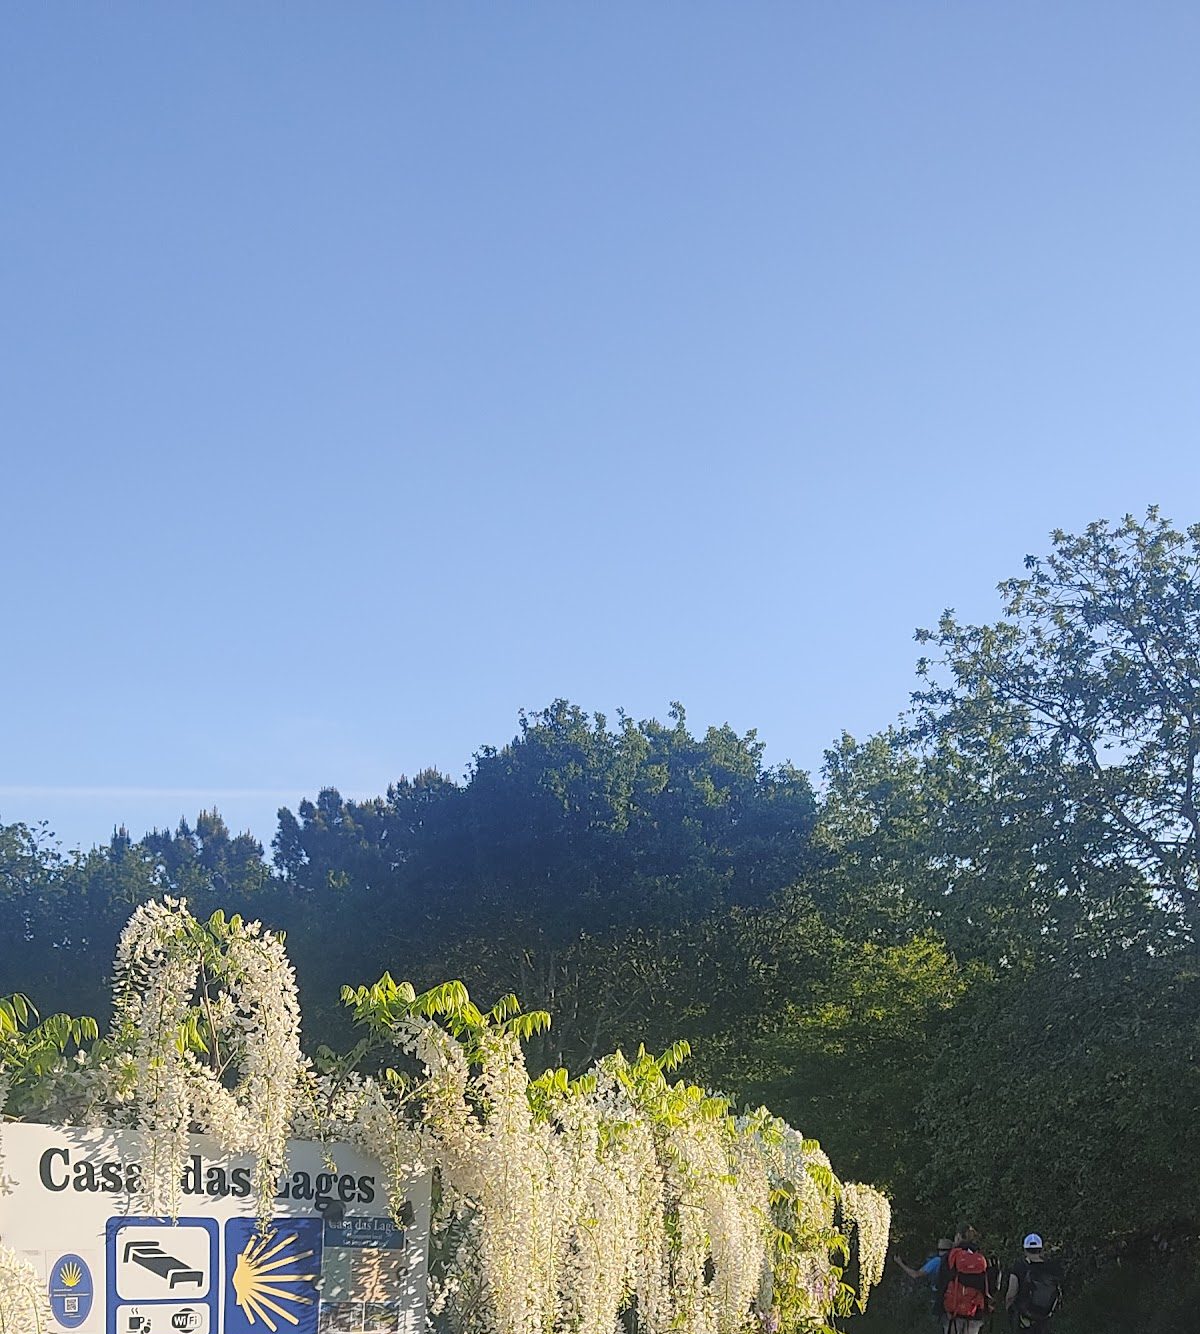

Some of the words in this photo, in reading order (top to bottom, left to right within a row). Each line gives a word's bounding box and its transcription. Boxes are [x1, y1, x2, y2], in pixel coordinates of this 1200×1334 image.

[39, 1147, 146, 1194] Casa
[180, 1154, 251, 1198] das
[374, 1219, 397, 1235] Lage
